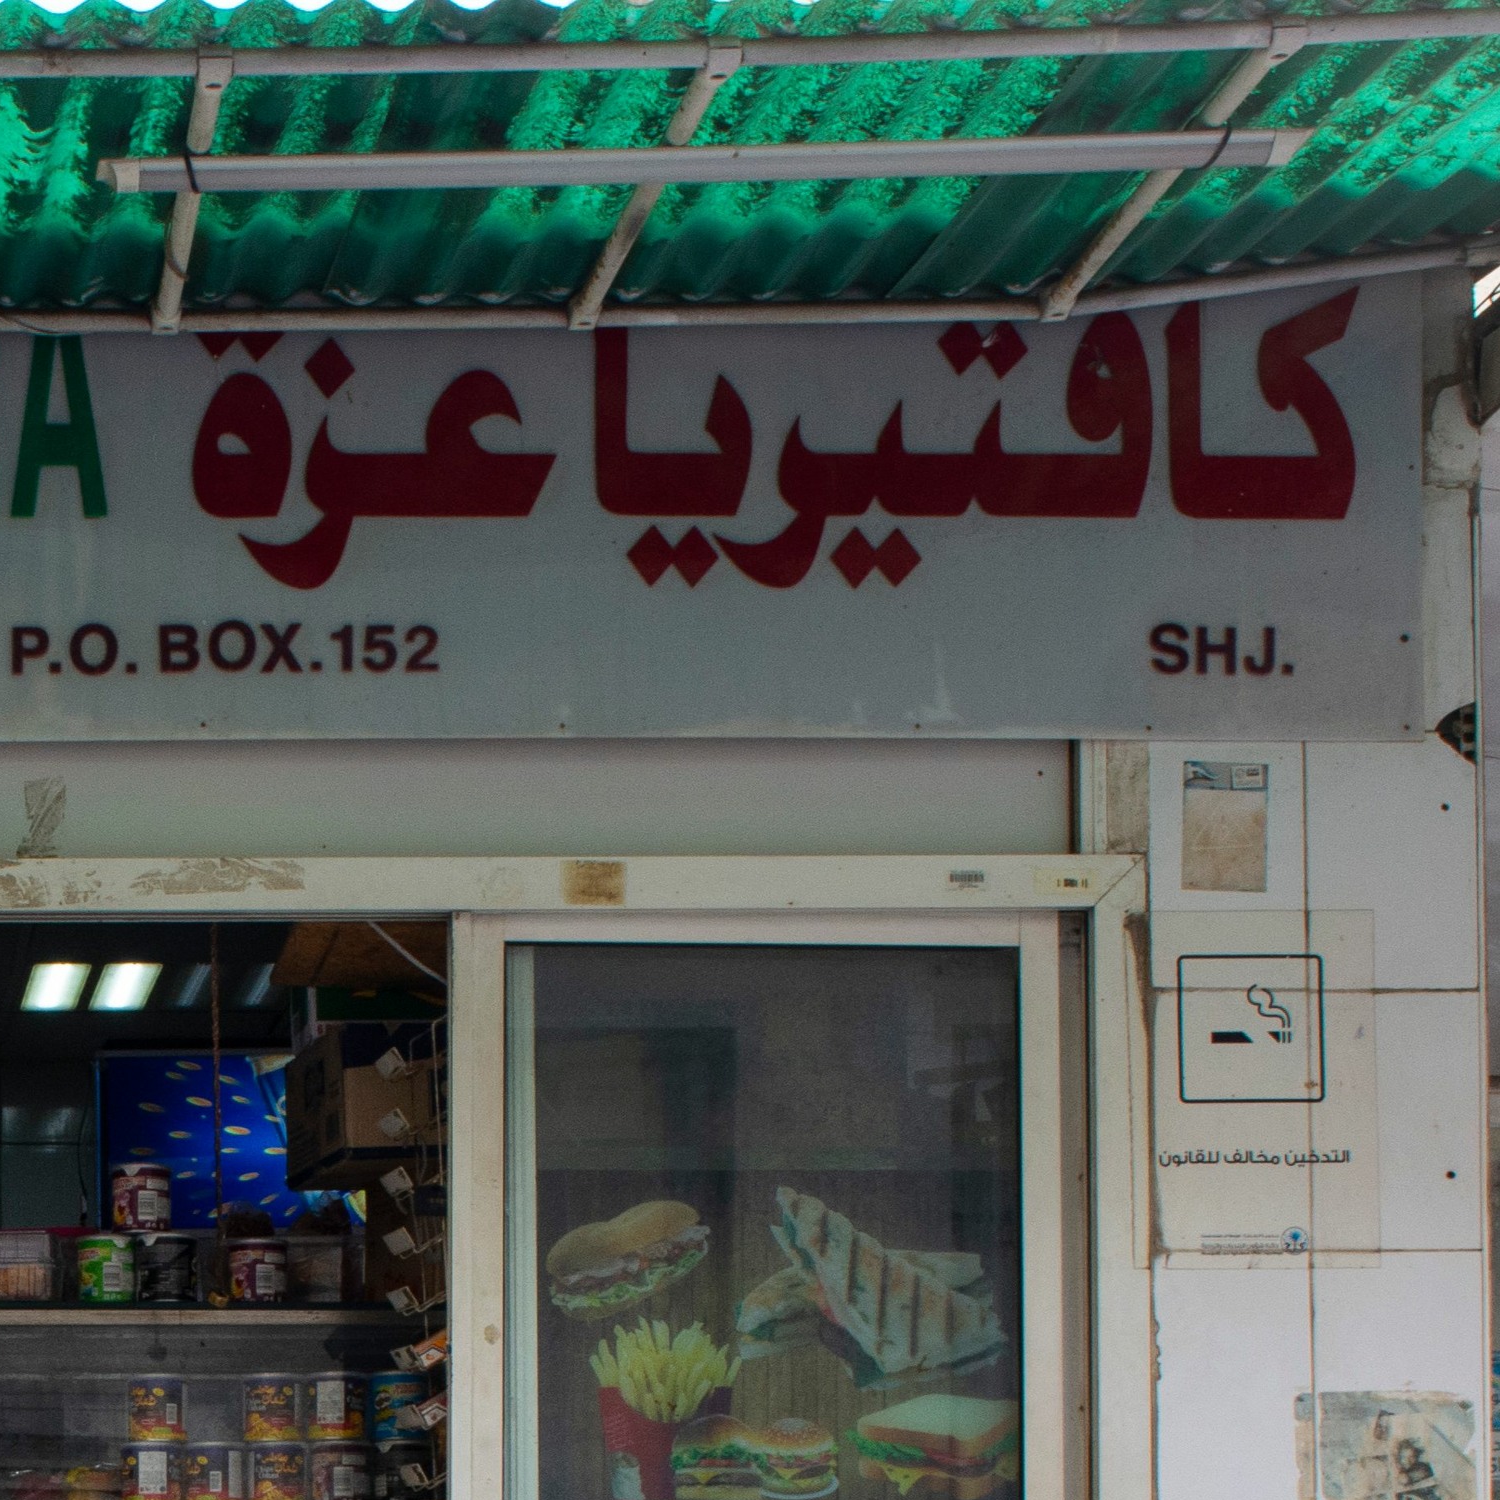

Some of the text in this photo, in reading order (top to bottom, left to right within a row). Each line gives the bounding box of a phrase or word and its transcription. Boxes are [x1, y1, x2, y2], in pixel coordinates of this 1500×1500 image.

[191, 285, 1360, 590] كافتيريا عزة
[1148, 621, 1296, 676] SHJ.
[1158, 1148, 1351, 1168] التدخين مخالف للقانون
